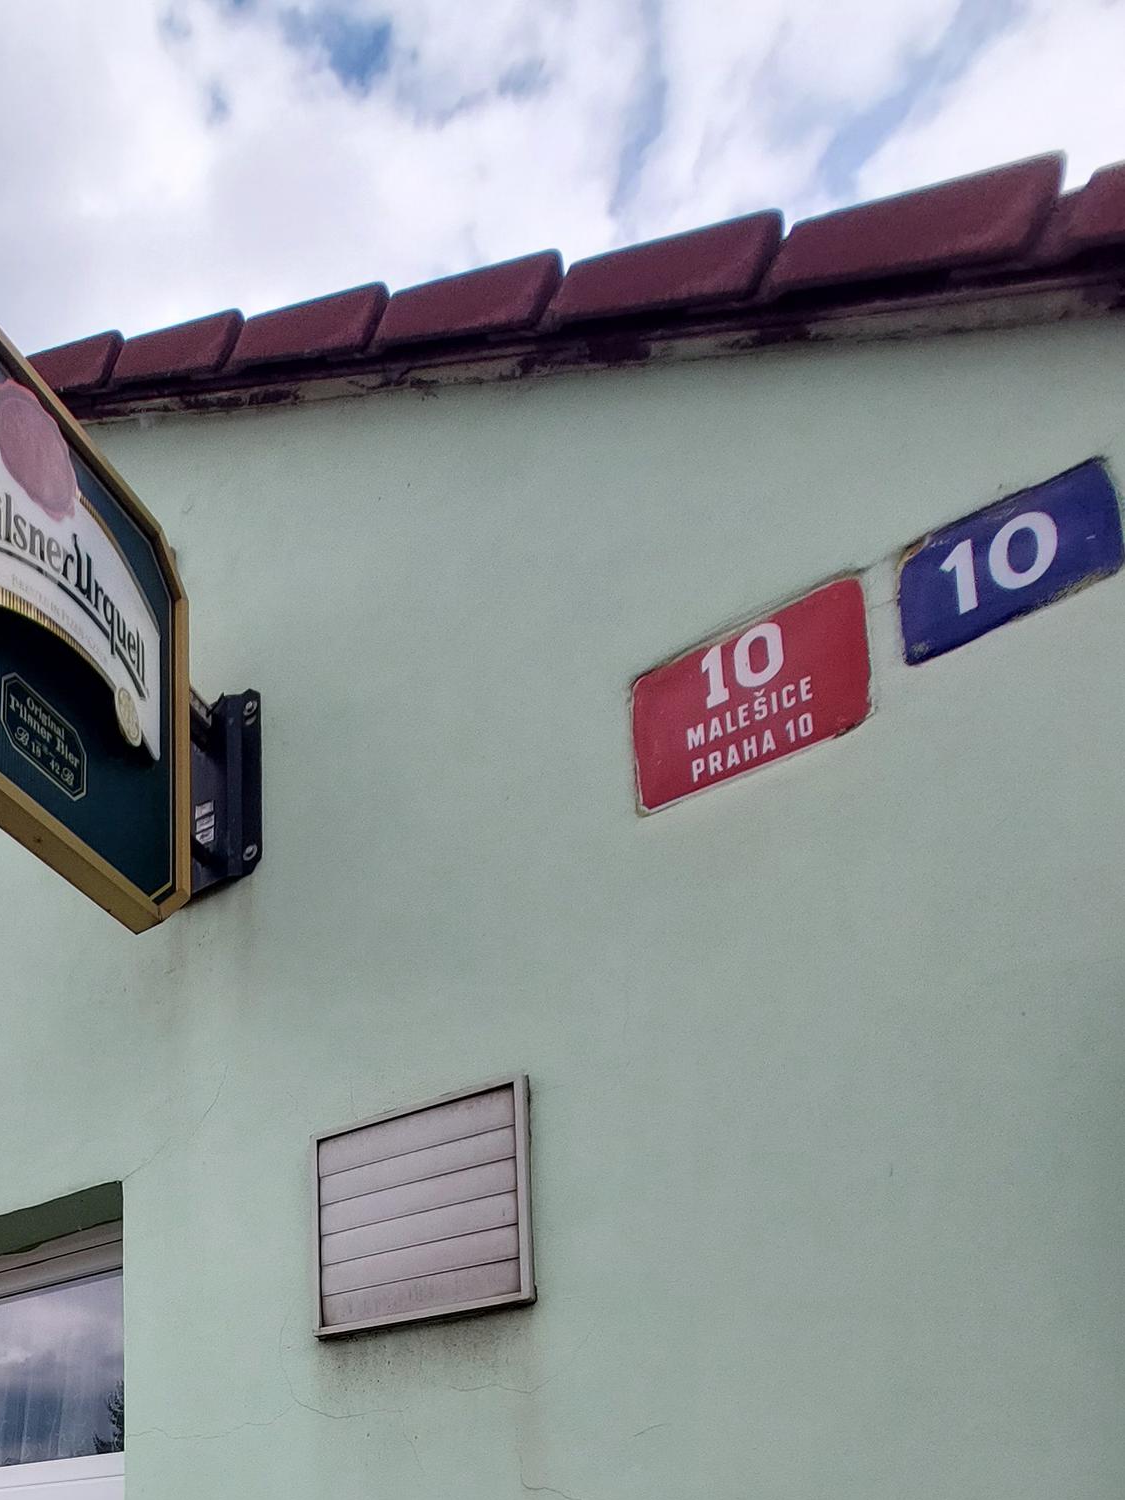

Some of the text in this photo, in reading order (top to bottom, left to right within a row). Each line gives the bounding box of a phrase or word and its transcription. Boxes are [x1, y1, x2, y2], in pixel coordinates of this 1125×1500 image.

[940, 511, 1058, 614] 10
[71, 533, 146, 690] Urquell
[701, 622, 784, 709] 10
[9, 693, 52, 742] Pilsner
[27, 696, 65, 740] Original
[686, 676, 813, 750] MALEŠICE
[692, 713, 814, 783] PRAHA 10
